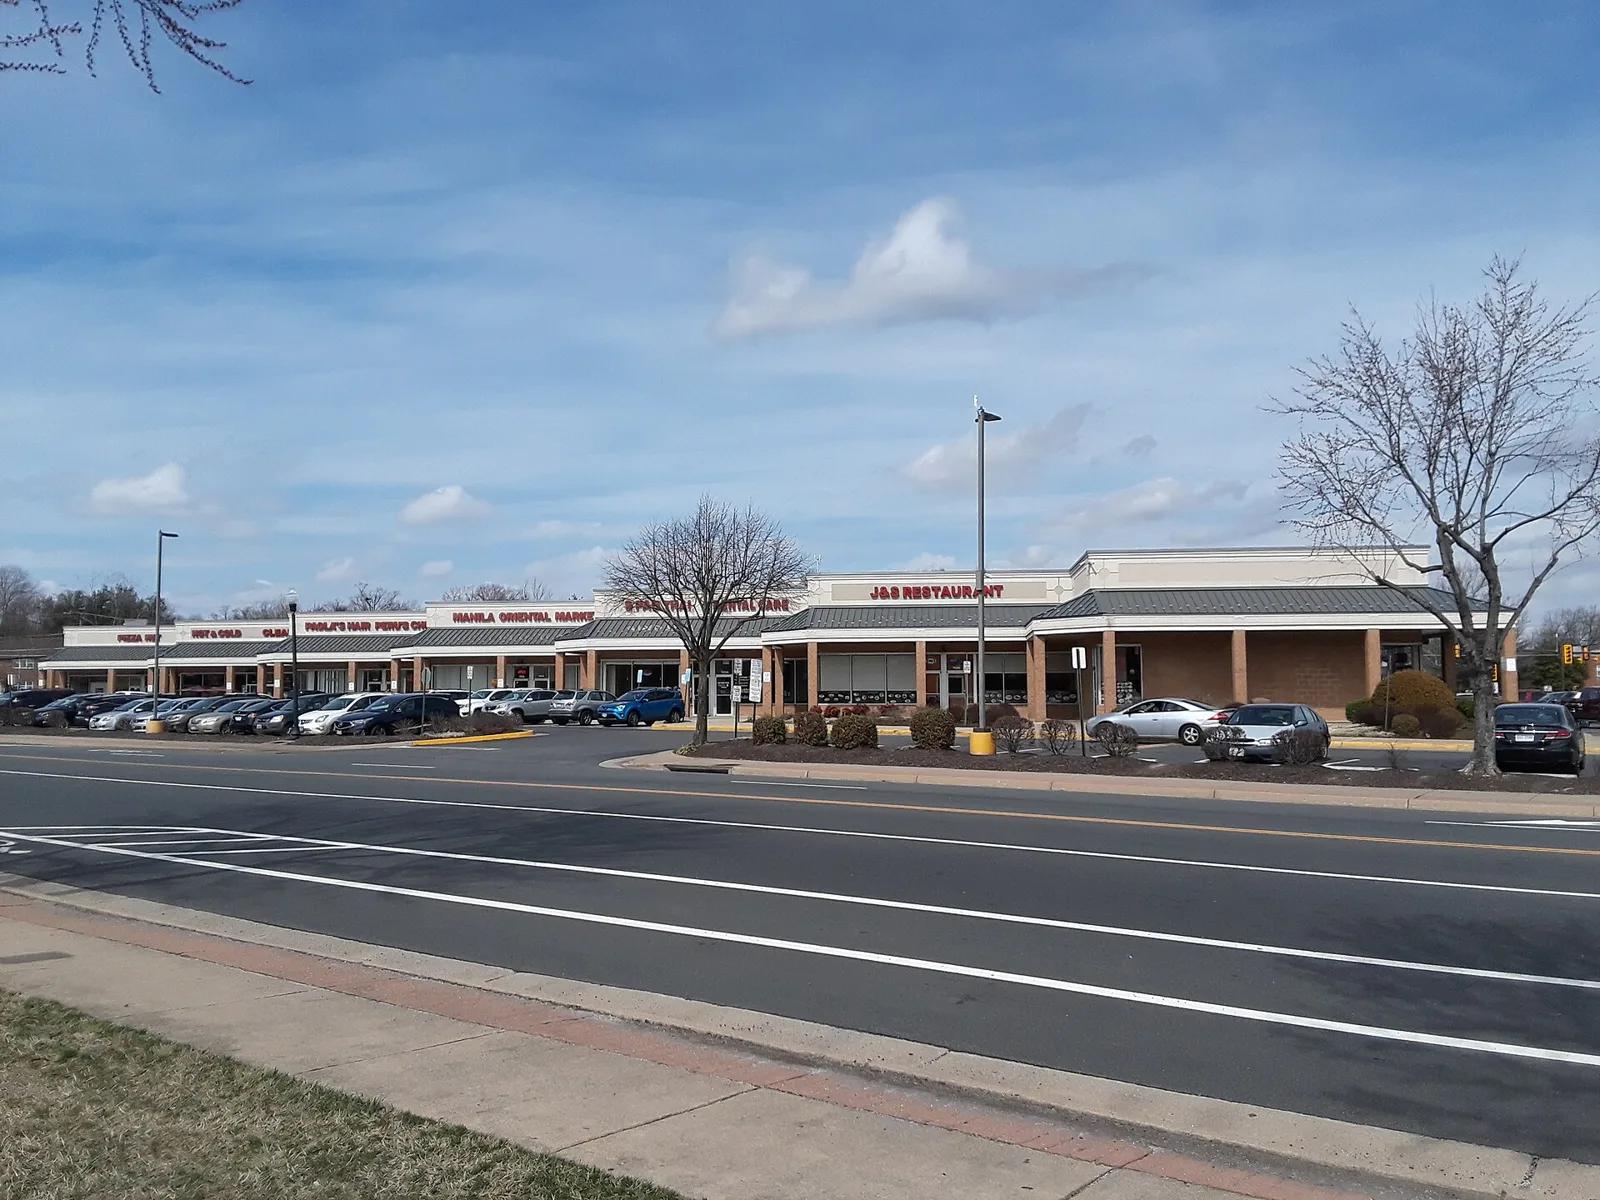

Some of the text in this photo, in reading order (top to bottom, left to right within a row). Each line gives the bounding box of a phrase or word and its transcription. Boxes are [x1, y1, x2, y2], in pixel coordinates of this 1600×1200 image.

[870, 586, 899, 600] J&S
[452, 612, 495, 623] MANILA
[498, 612, 552, 623] ORIENTAL
[262, 628, 289, 638] CLEA
